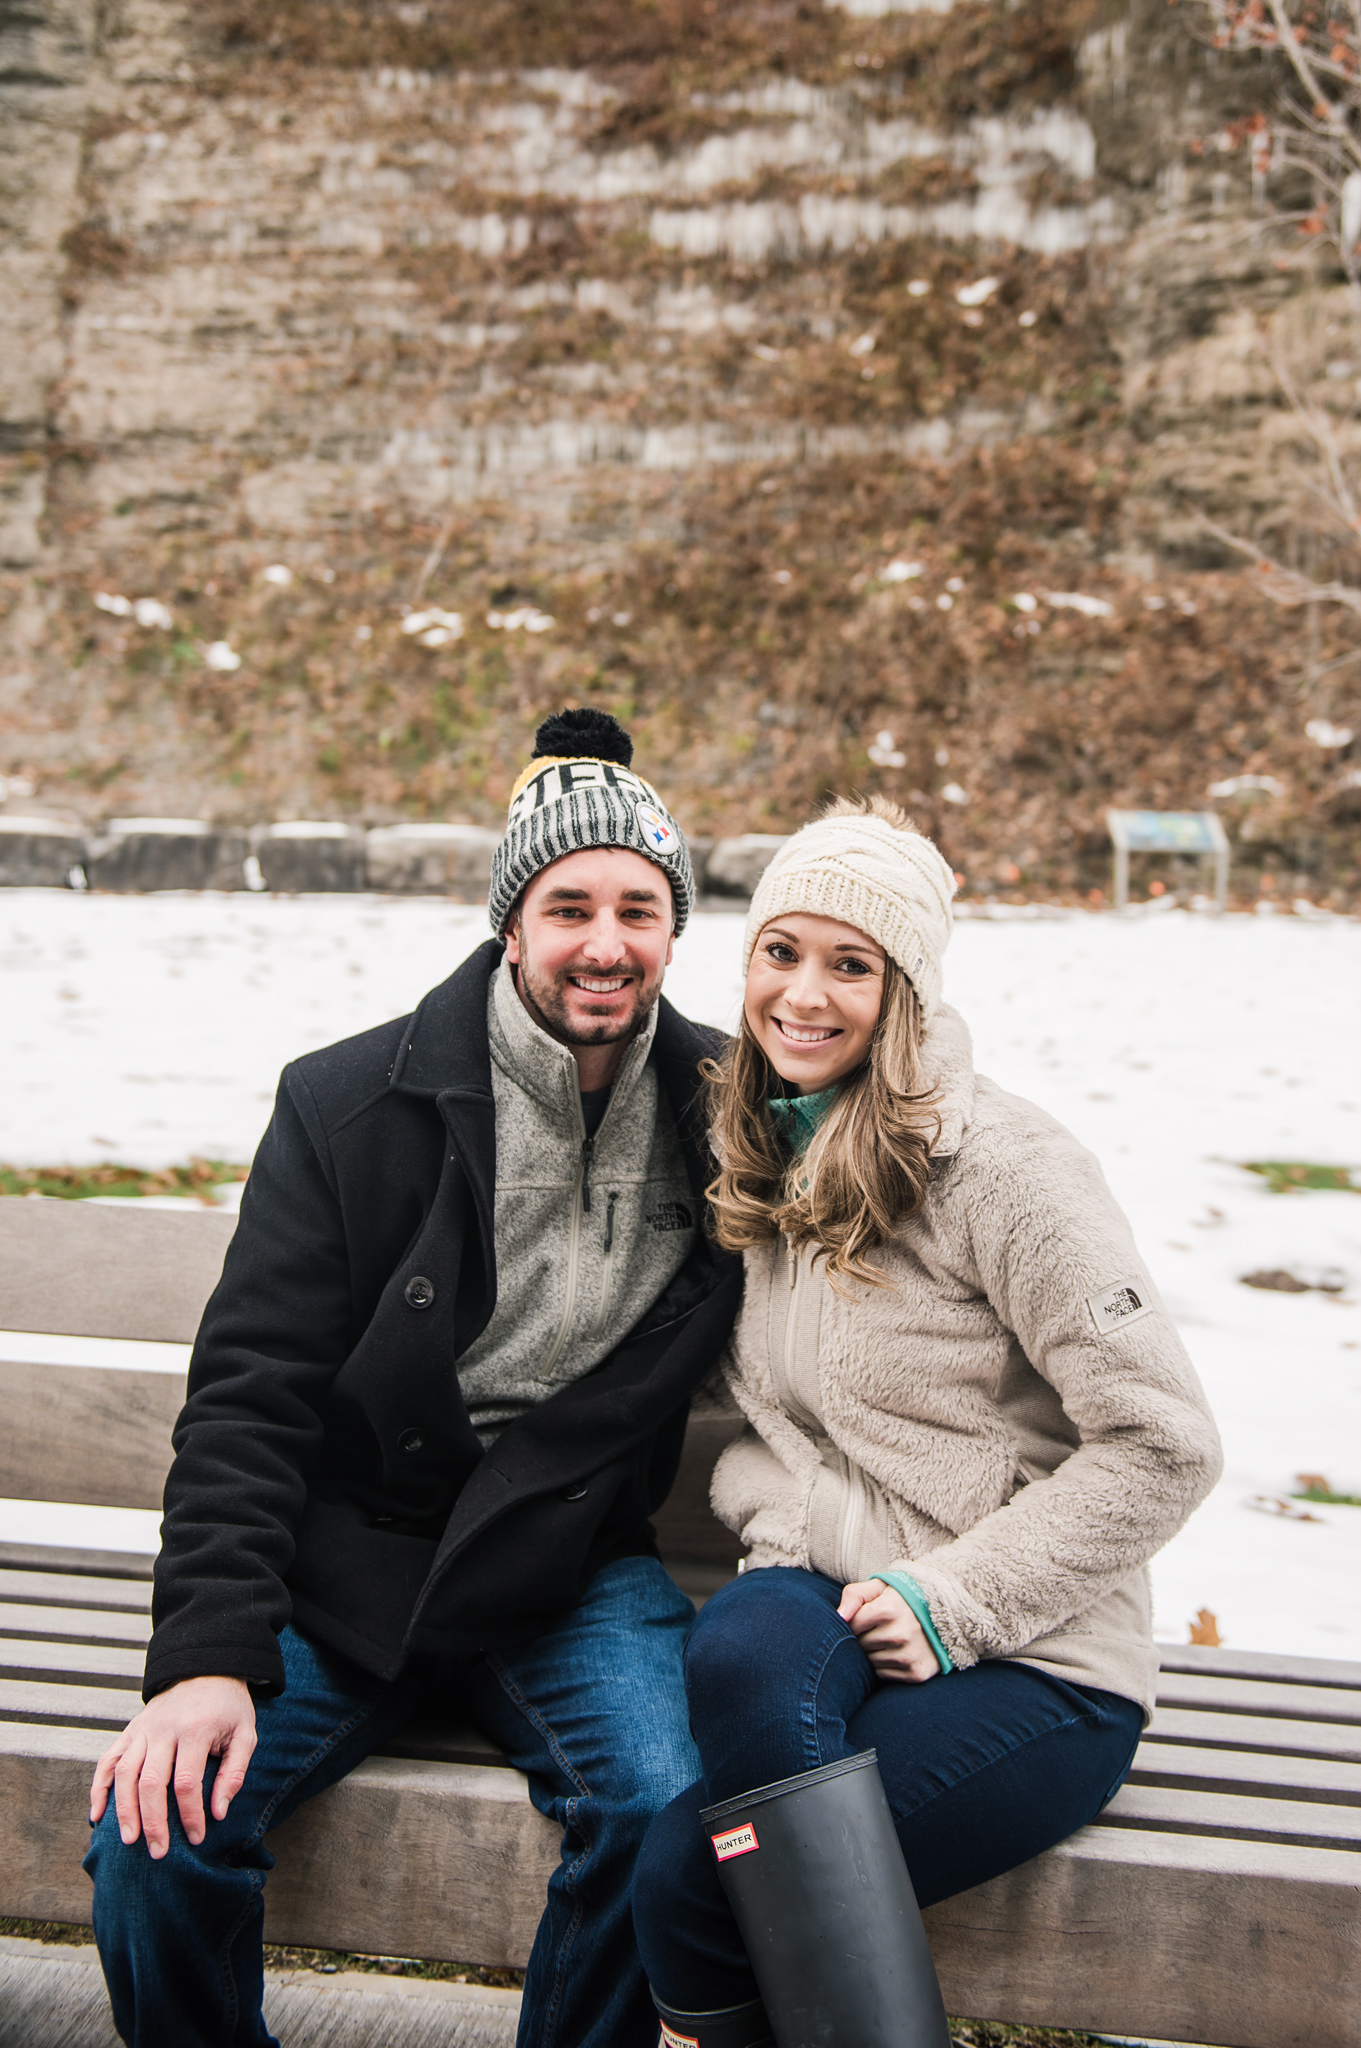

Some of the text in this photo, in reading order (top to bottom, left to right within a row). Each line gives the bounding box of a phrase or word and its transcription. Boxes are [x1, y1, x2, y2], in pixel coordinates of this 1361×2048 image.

[657, 1203, 675, 1213] THE
[645, 1212, 676, 1224] NORTH
[653, 1221, 678, 1232] FACE
[1113, 1288, 1127, 1300] THE
[1104, 1297, 1130, 1314] NORTH
[1115, 1304, 1134, 1319] FACE
[716, 1833, 752, 1851] HUNTER
